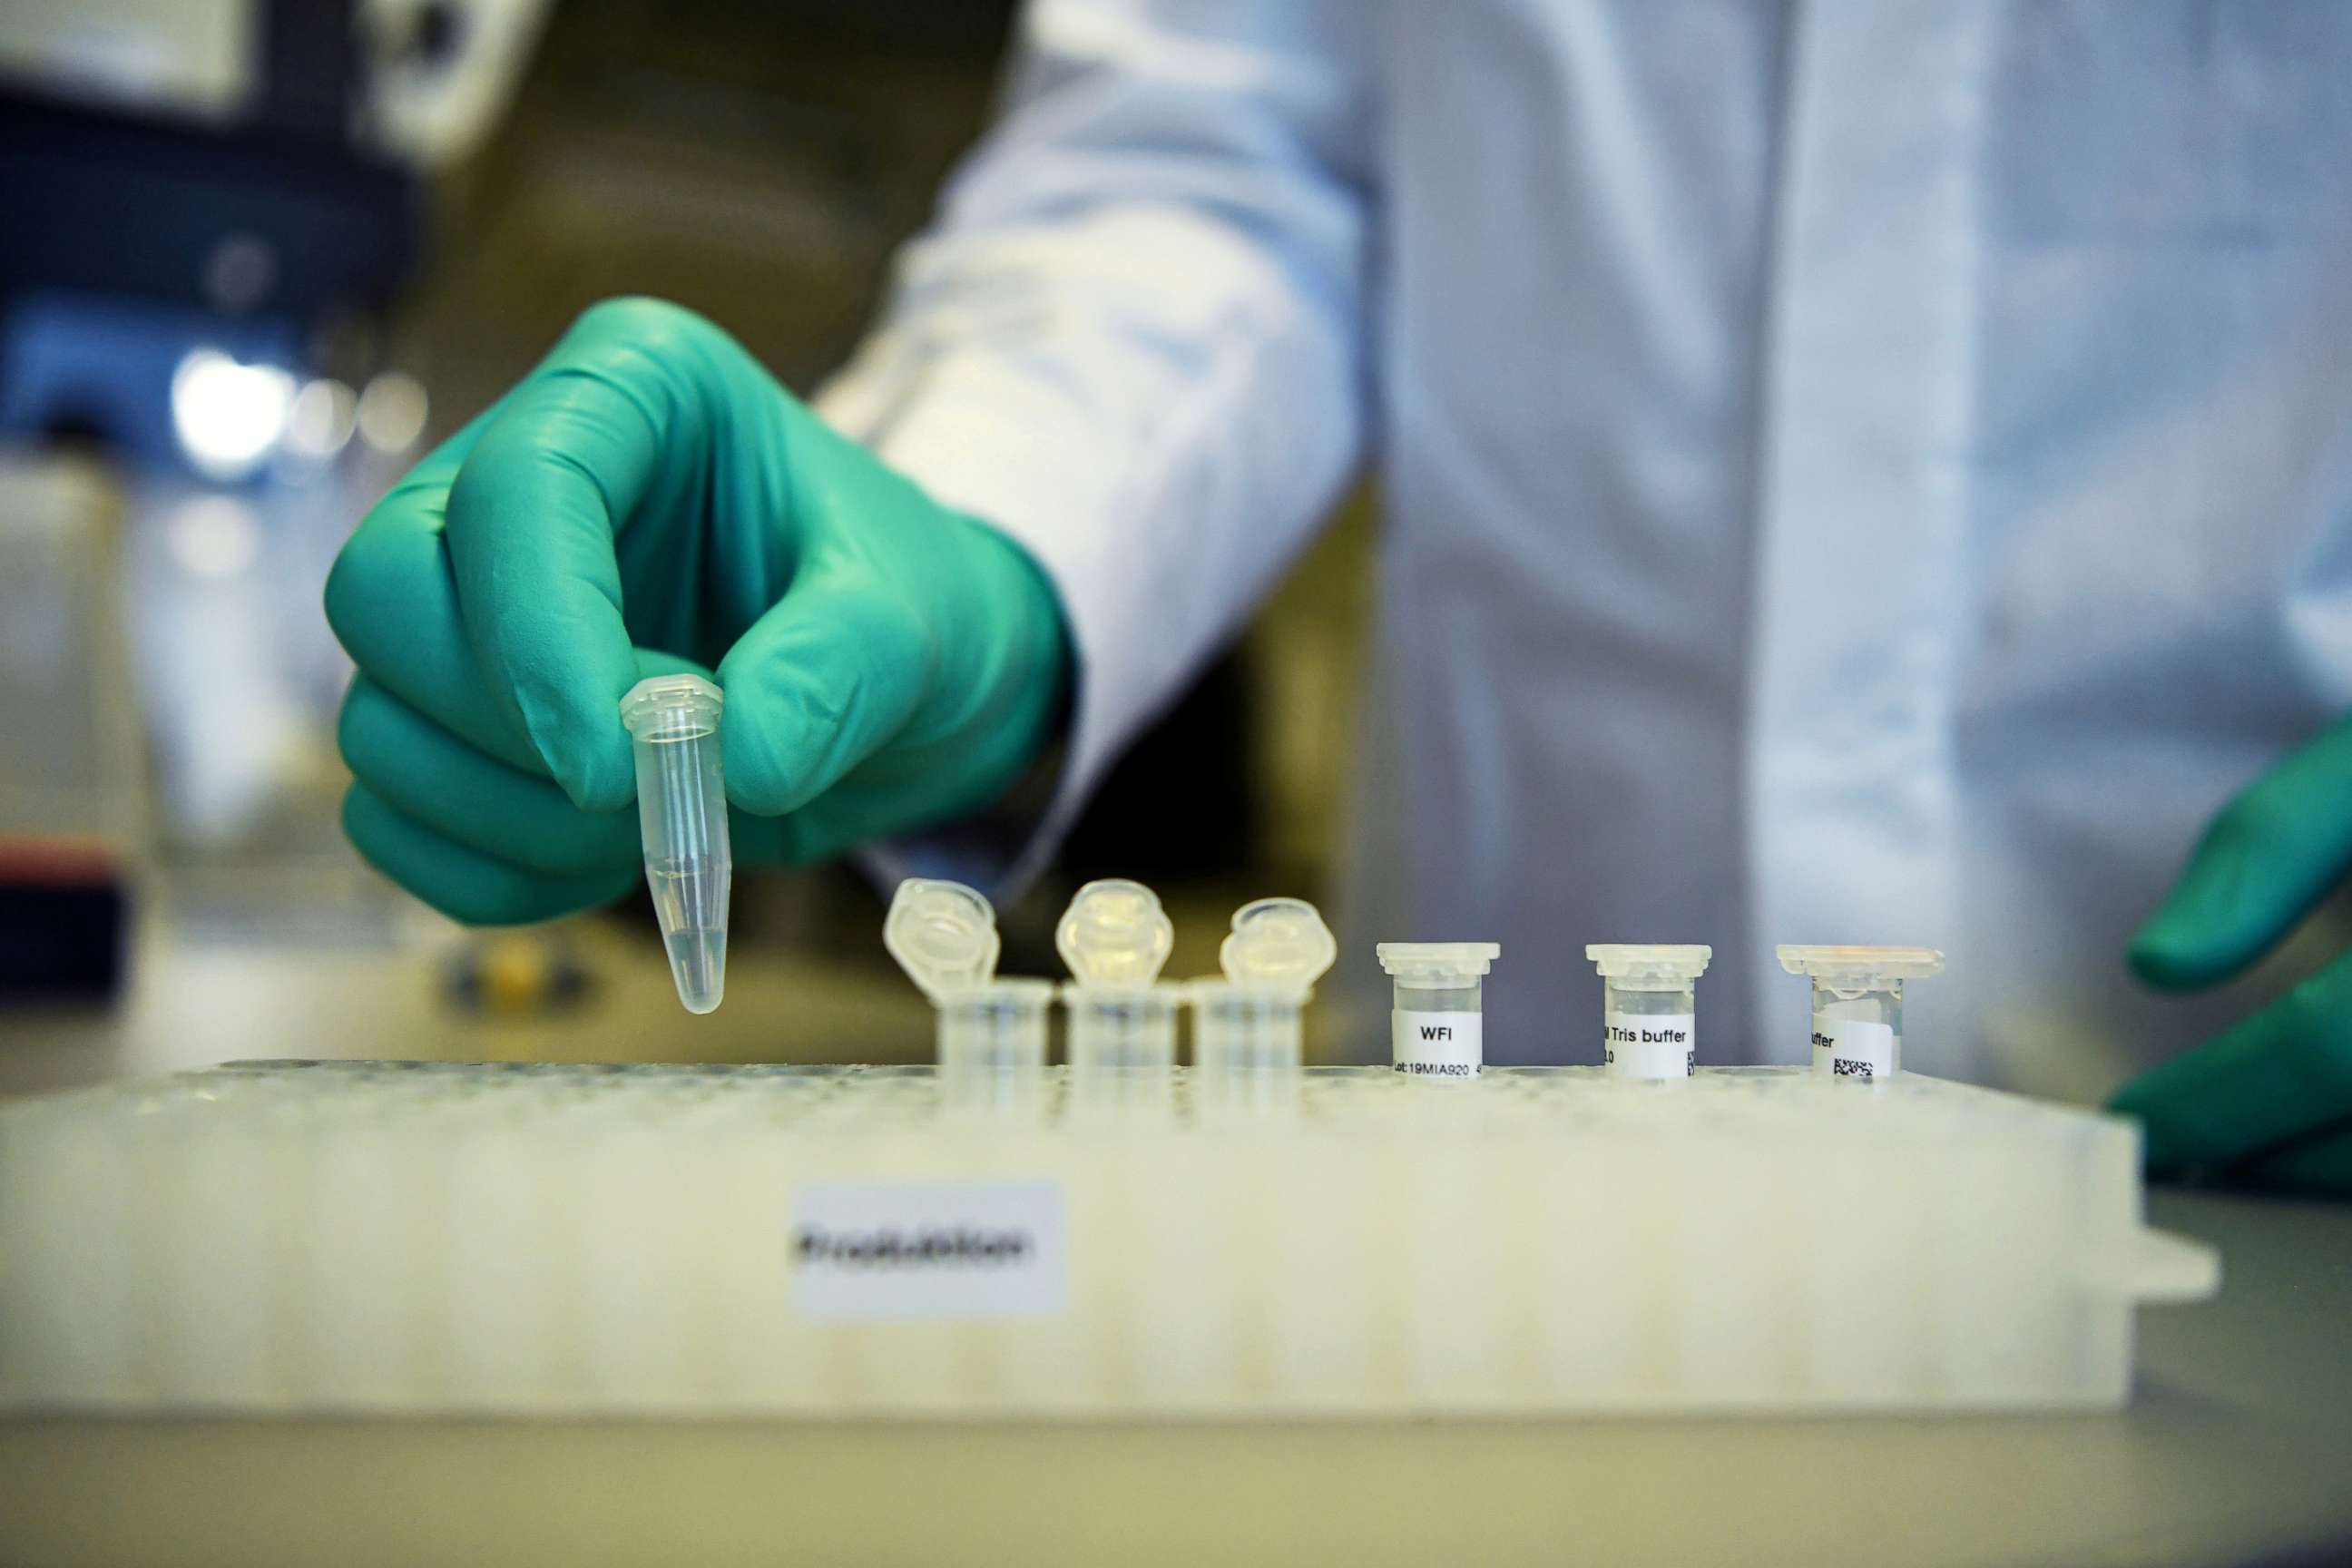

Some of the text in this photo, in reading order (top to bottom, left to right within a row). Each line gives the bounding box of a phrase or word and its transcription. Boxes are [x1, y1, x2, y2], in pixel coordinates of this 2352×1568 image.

[1420, 1026, 1452, 1041] WFI
[1612, 1027, 1637, 1042] Tris
[1642, 1029, 1686, 1043] buffer
